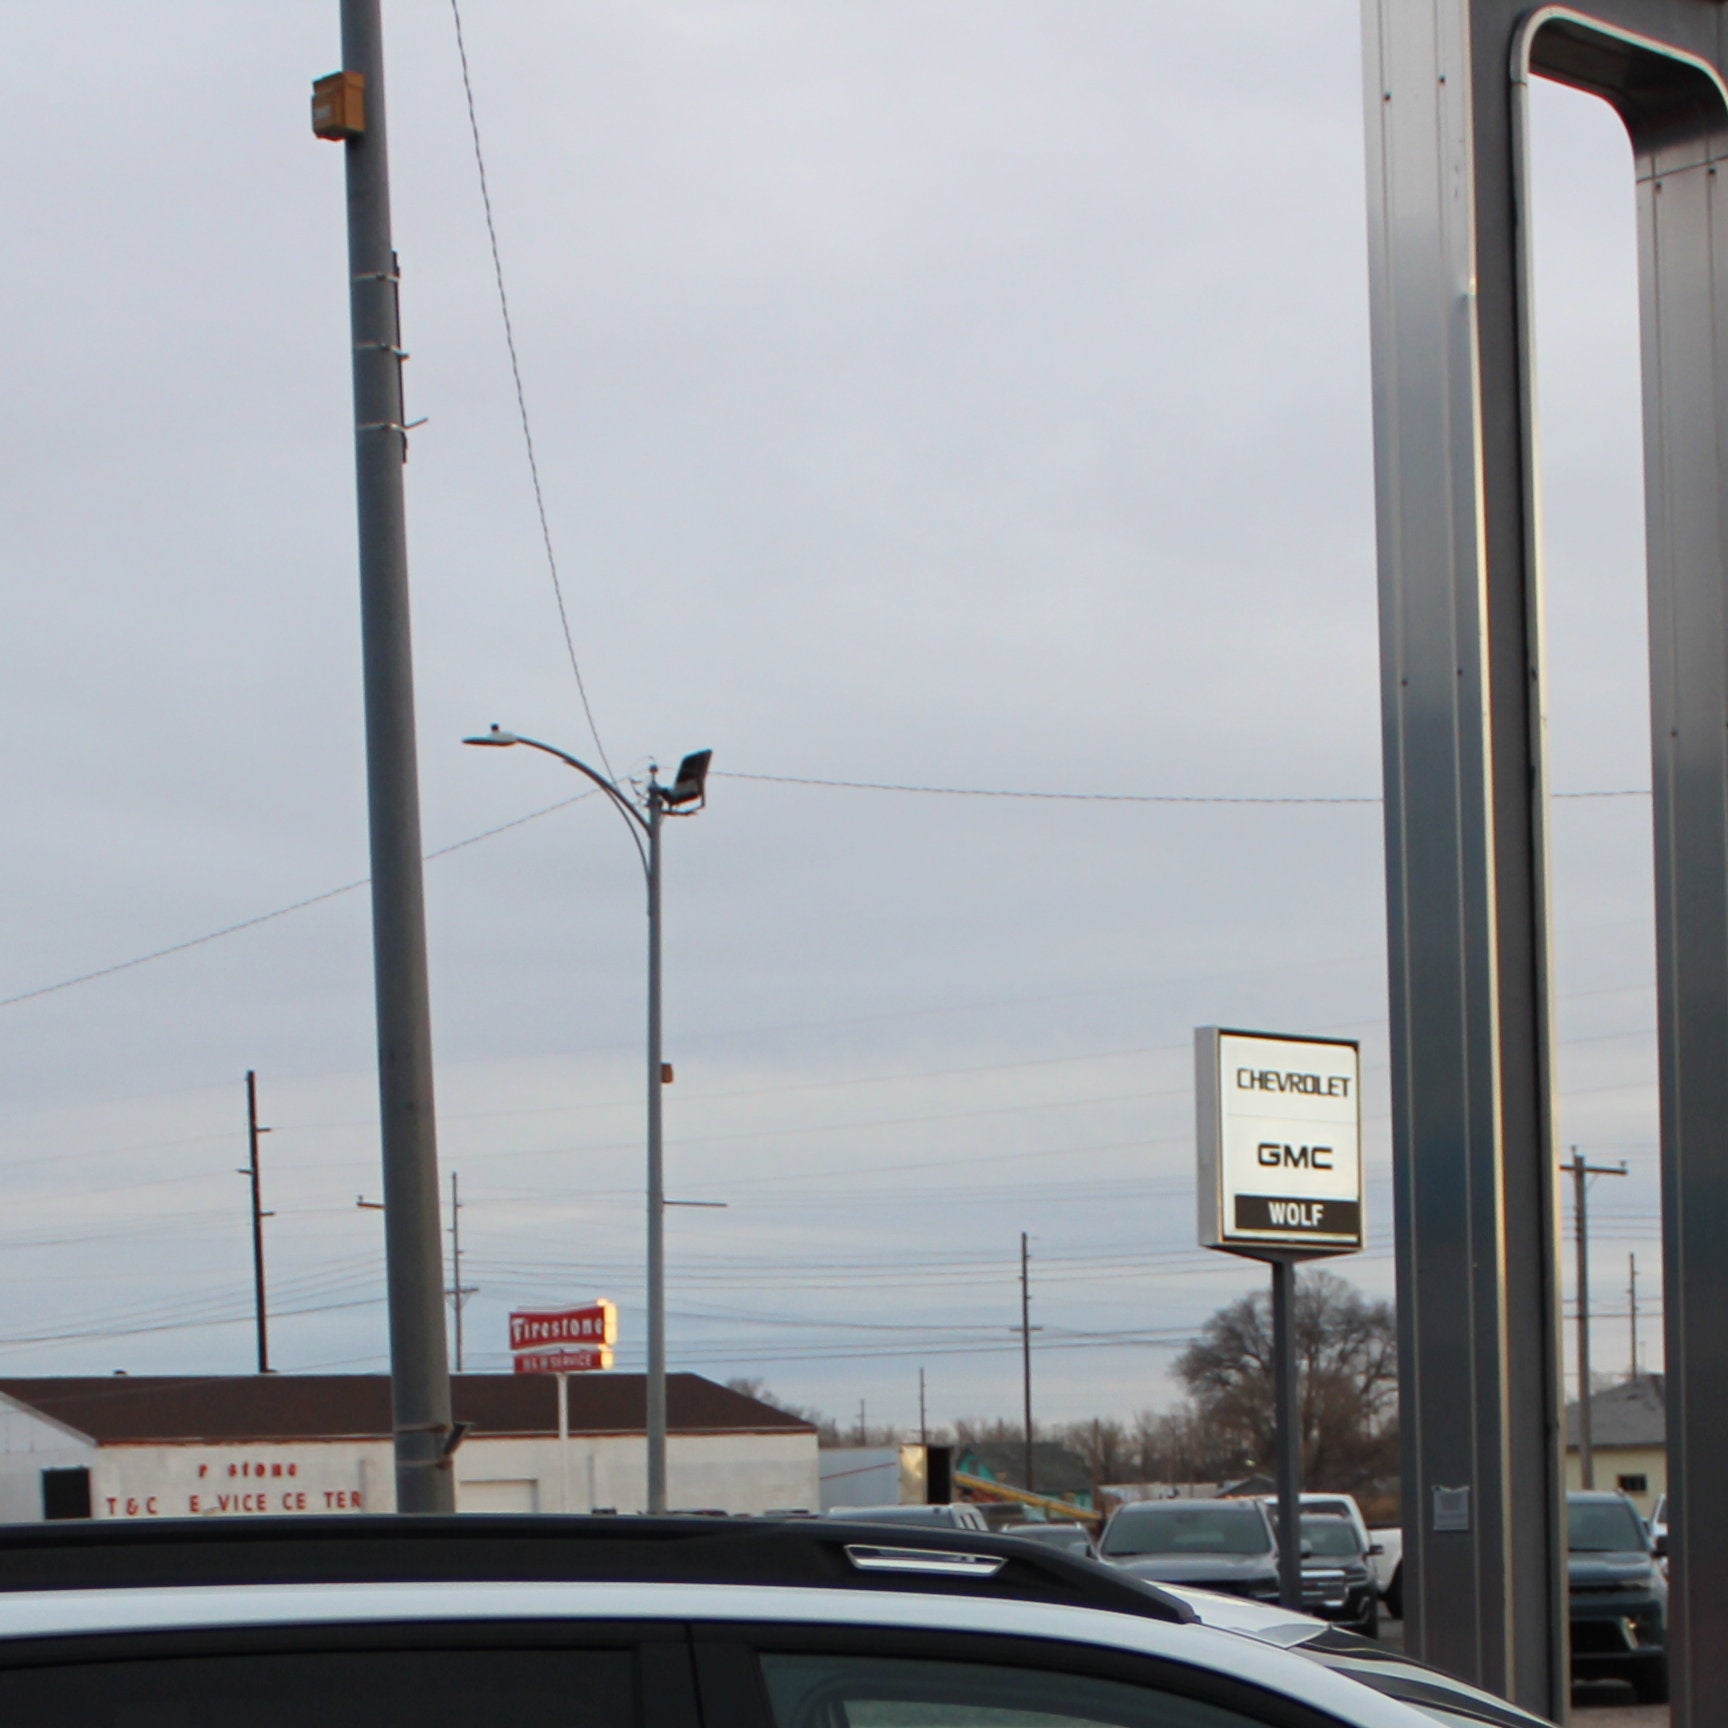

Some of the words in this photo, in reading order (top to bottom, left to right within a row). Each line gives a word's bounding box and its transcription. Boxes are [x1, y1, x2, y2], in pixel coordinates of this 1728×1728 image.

[1236, 1067, 1351, 1097] CHEVROLET
[1257, 1142, 1333, 1170] GMC
[1268, 1201, 1324, 1227] WOLF
[512, 1317, 603, 1343] Firestone
